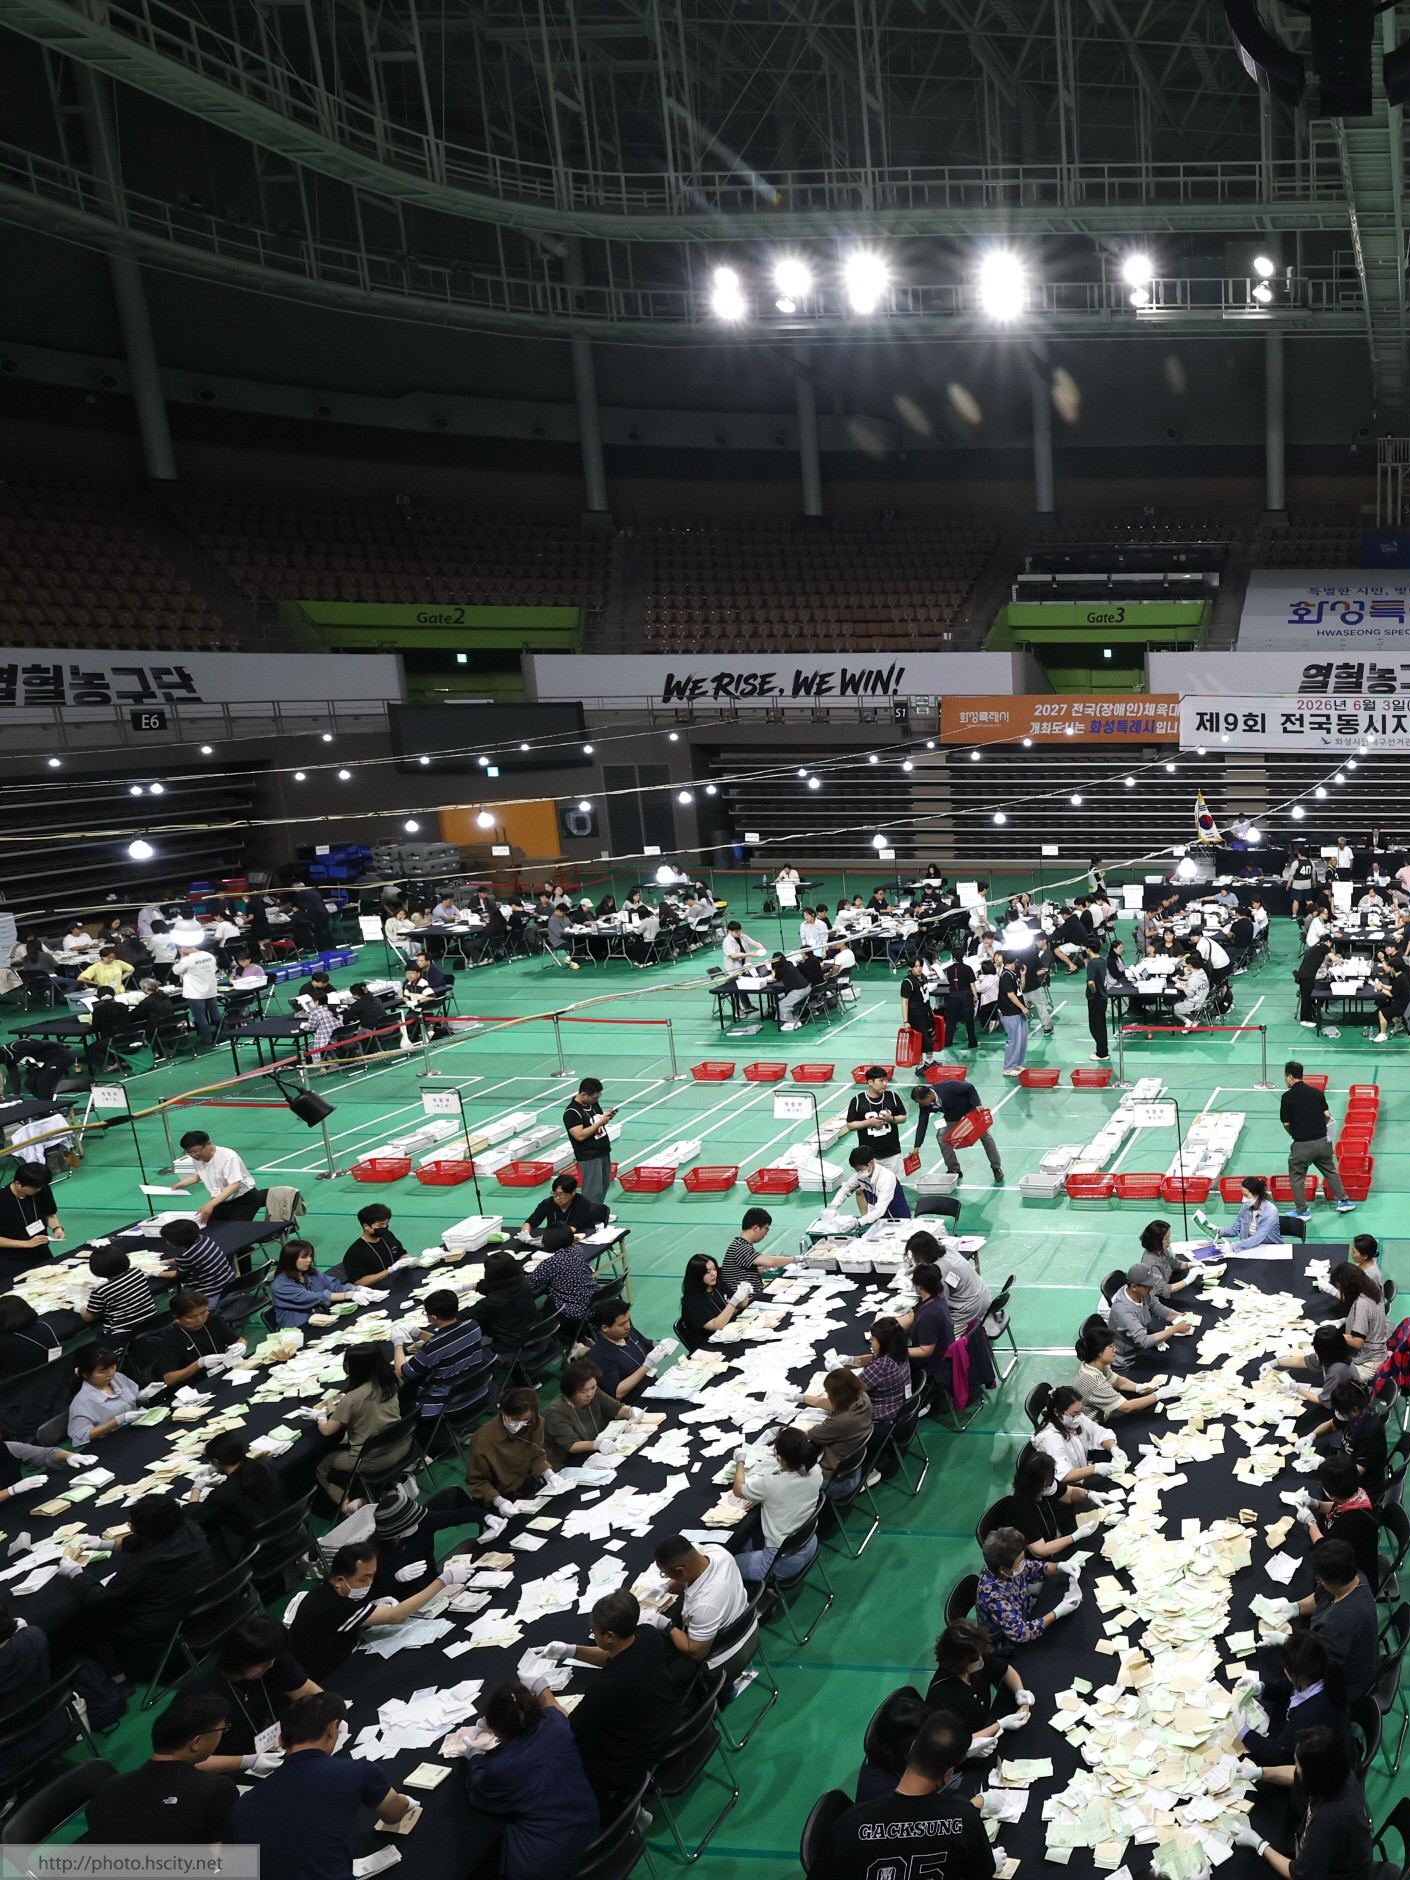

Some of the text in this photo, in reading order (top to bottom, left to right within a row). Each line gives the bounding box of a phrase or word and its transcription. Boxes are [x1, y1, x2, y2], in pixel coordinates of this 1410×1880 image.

[1308, 586, 1351, 596] 특별한
[416, 607, 466, 625] Gate2
[1086, 606, 1126, 624] Gate3
[1316, 628, 1381, 637] HWASEONG
[661, 658, 906, 704] WE RISE, WE WIN!
[895, 707, 906, 719] S1
[1033, 703, 1067, 717] 2027
[1296, 699, 1347, 712] 2026년
[1353, 699, 1376, 712] 6월
[141, 714, 160, 729] E6
[1089, 719, 1180, 735] 화성특례시입니
[1195, 711, 1266, 734] 제9회
[1299, 865, 1312, 876] 40
[857, 1817, 964, 1841] GACKSUNG
